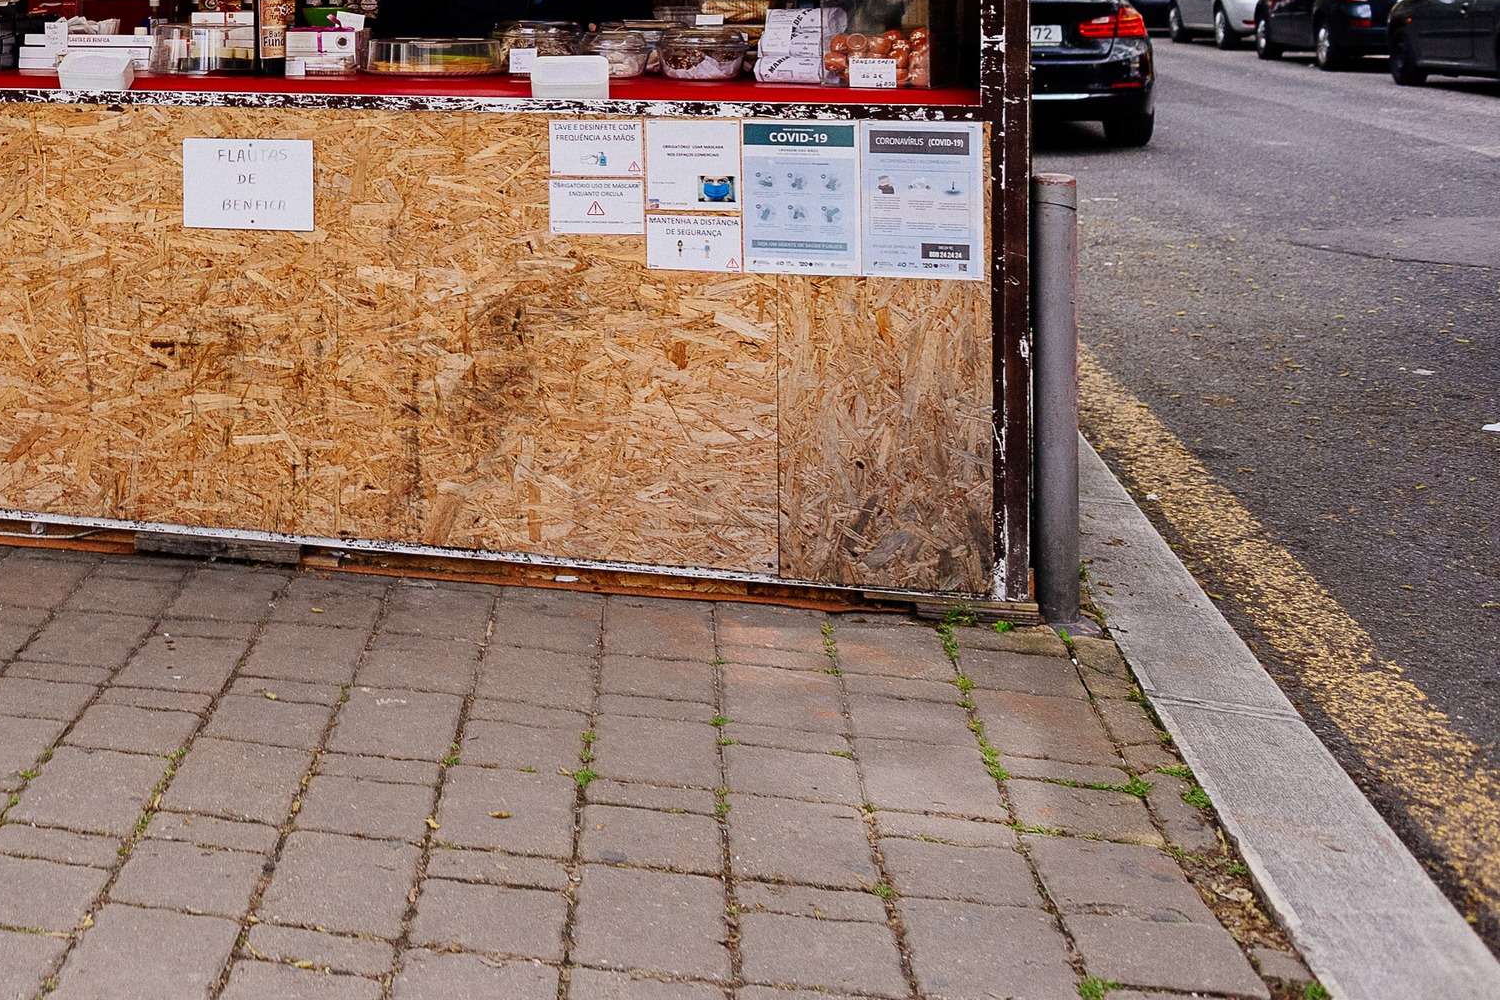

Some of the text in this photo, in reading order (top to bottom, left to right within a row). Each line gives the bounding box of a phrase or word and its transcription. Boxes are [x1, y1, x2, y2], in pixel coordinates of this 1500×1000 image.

[1033, 28, 1053, 41] 72
[554, 123, 572, 131] LAVE
[579, 123, 617, 131] DESINFETE
[555, 133, 601, 142] FREQUÊNCIA
[613, 133, 635, 142] MÃOS
[769, 132, 828, 143] COVID-19
[875, 136, 964, 148] CORONAVÍRUS (COVID-19)
[218, 148, 288, 162] FLAUTAS
[237, 173, 257, 185] DE
[553, 181, 589, 189] OBRIGATÓRIO
[222, 198, 287, 211] BENFICA
[649, 217, 691, 226] MANTENHA
[693, 218, 699, 226] A
[700, 217, 739, 227] DISTÂNCIA
[666, 228, 722, 237] DE SEGURANÇA
